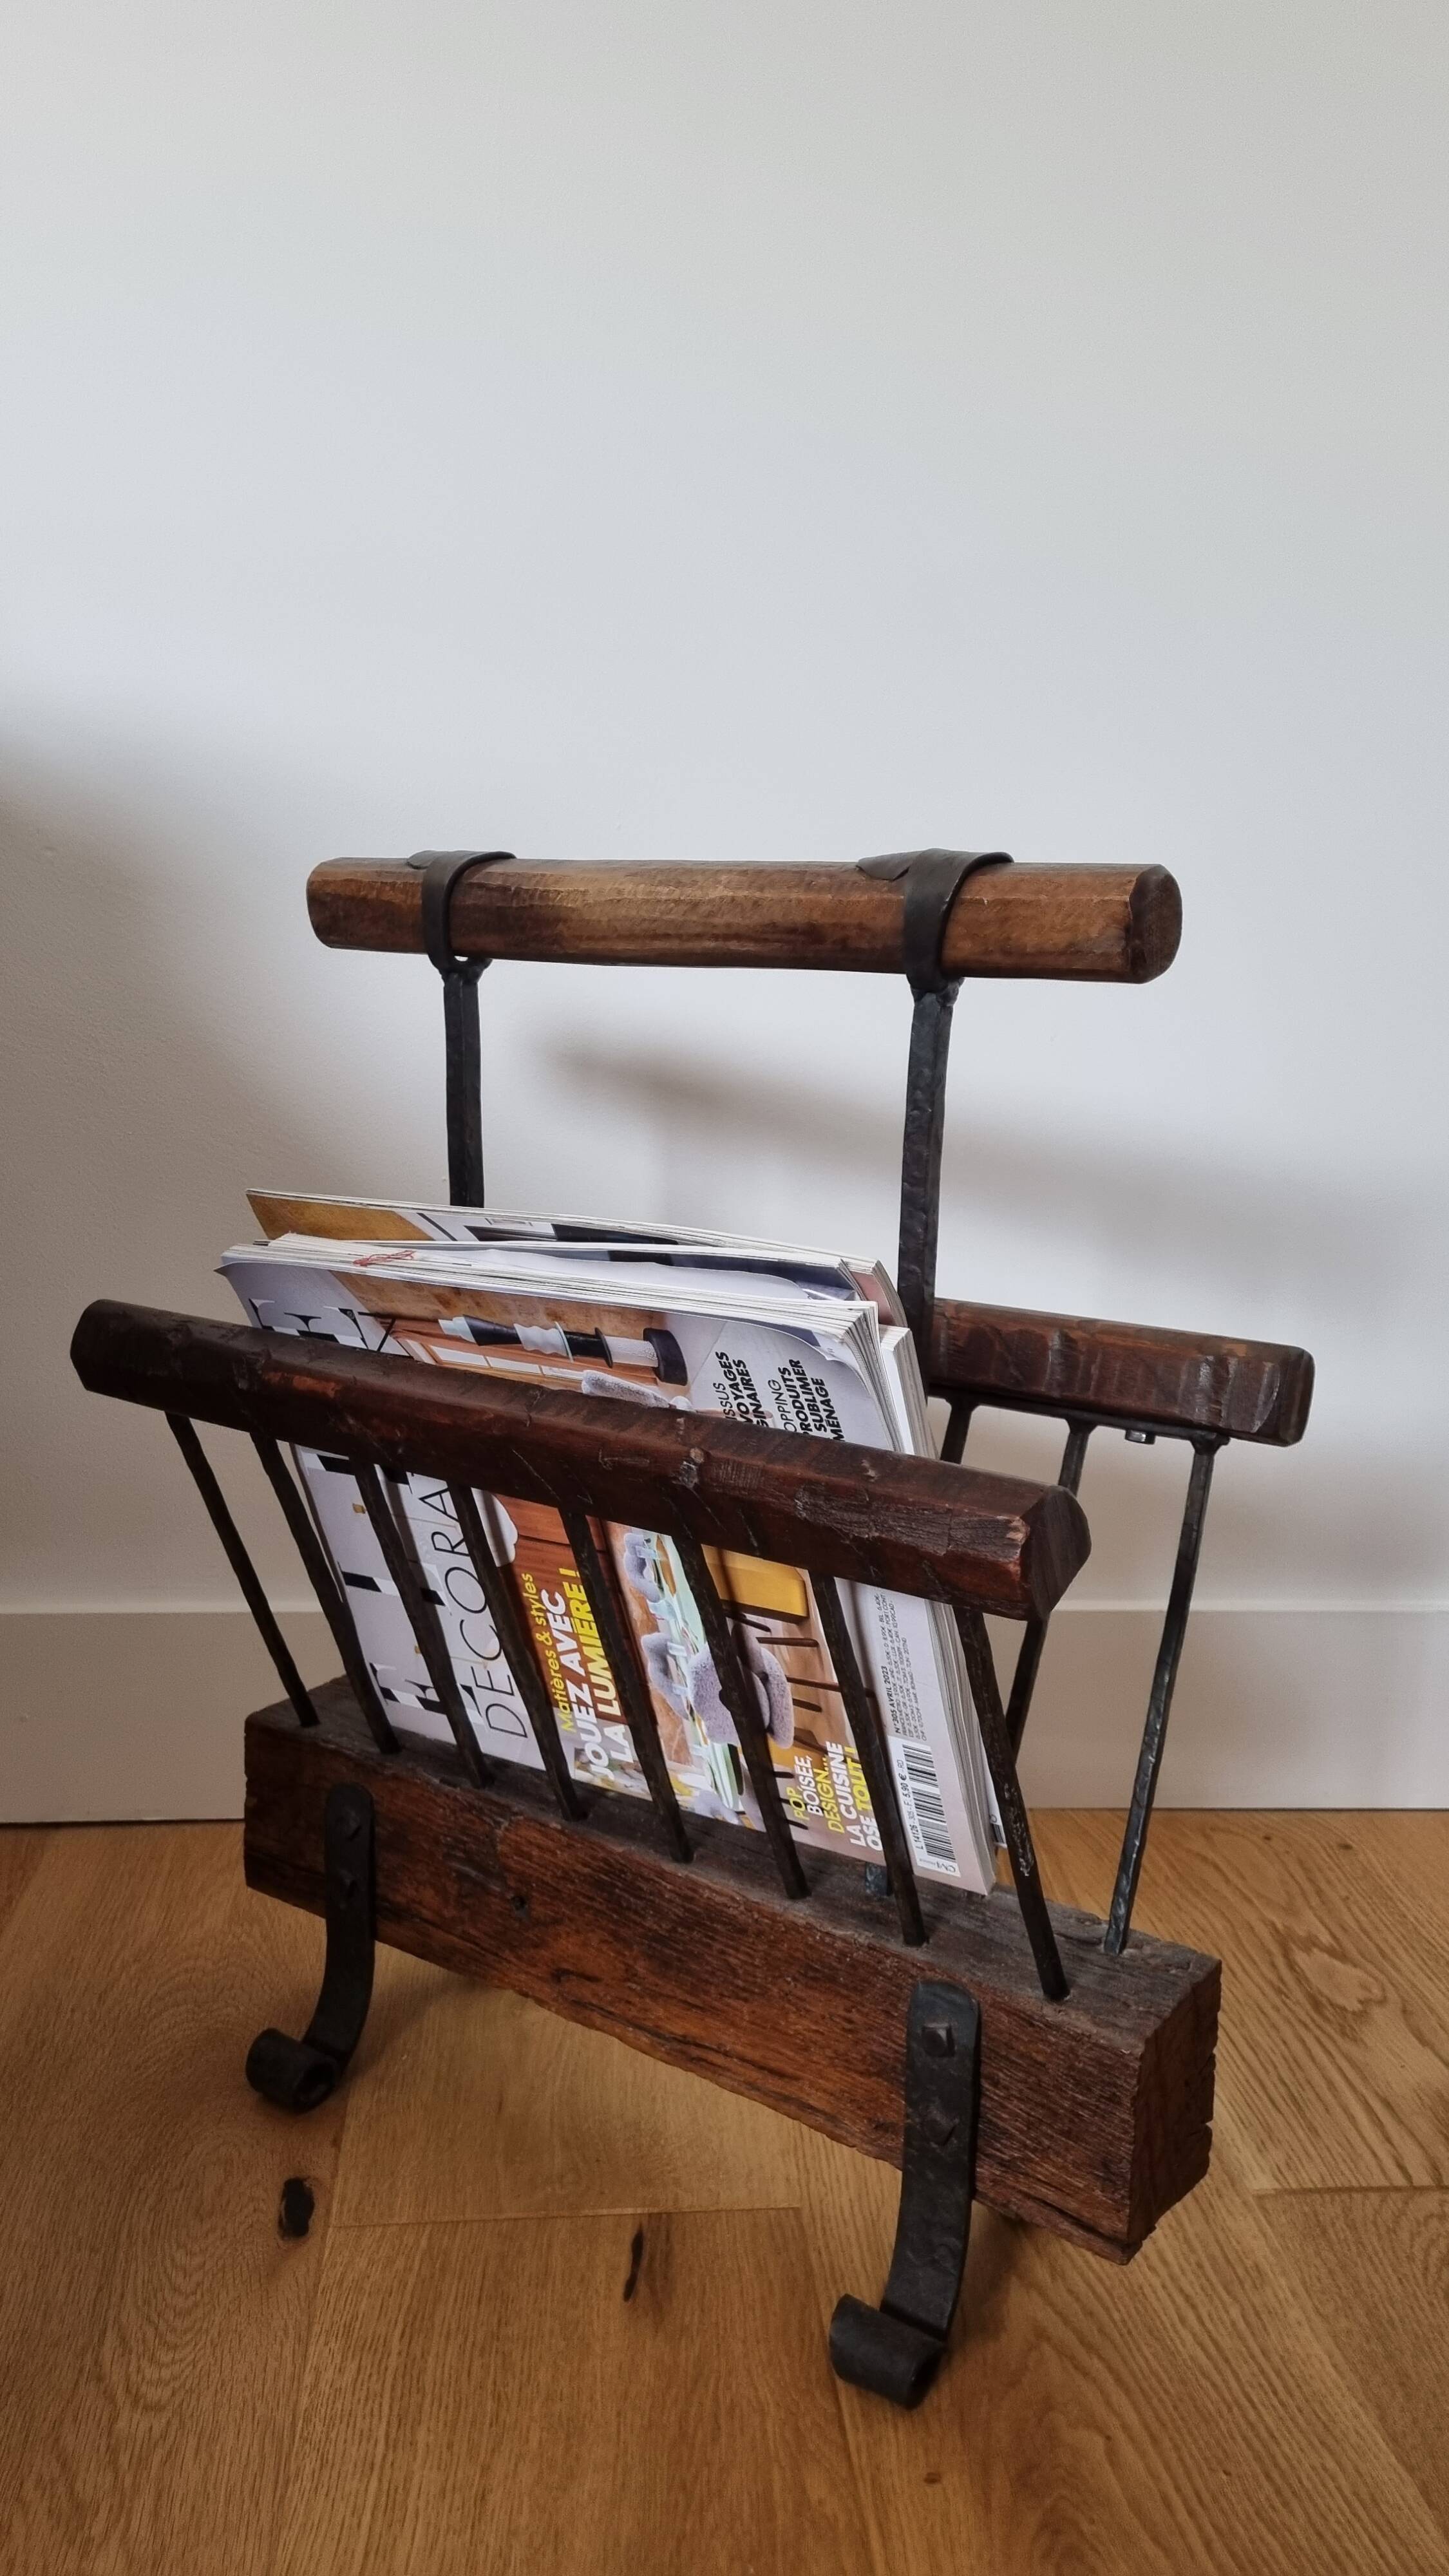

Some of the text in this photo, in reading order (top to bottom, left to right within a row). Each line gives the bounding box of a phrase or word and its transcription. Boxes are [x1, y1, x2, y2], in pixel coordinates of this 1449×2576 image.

[713, 1383, 737, 1420] ISSUS
[733, 1359, 769, 1427] GINAIRES
[768, 1380, 797, 1432] OPPING
[789, 1359, 827, 1432] SUBLIMER
[522, 1573, 576, 1733] Matières & styles
[563, 1582, 621, 1717] LUMIÈRE
[882, 1666, 892, 1684] 2023
[541, 1589, 614, 1781] JOUEZ AVEC
[886, 1686, 898, 1708] AVRIL
[603, 1725, 634, 1763] LA
[826, 1741, 867, 1846] LA CUISINE
[847, 1757, 873, 1811] TOUT
[860, 1815, 883, 1851] OSE
